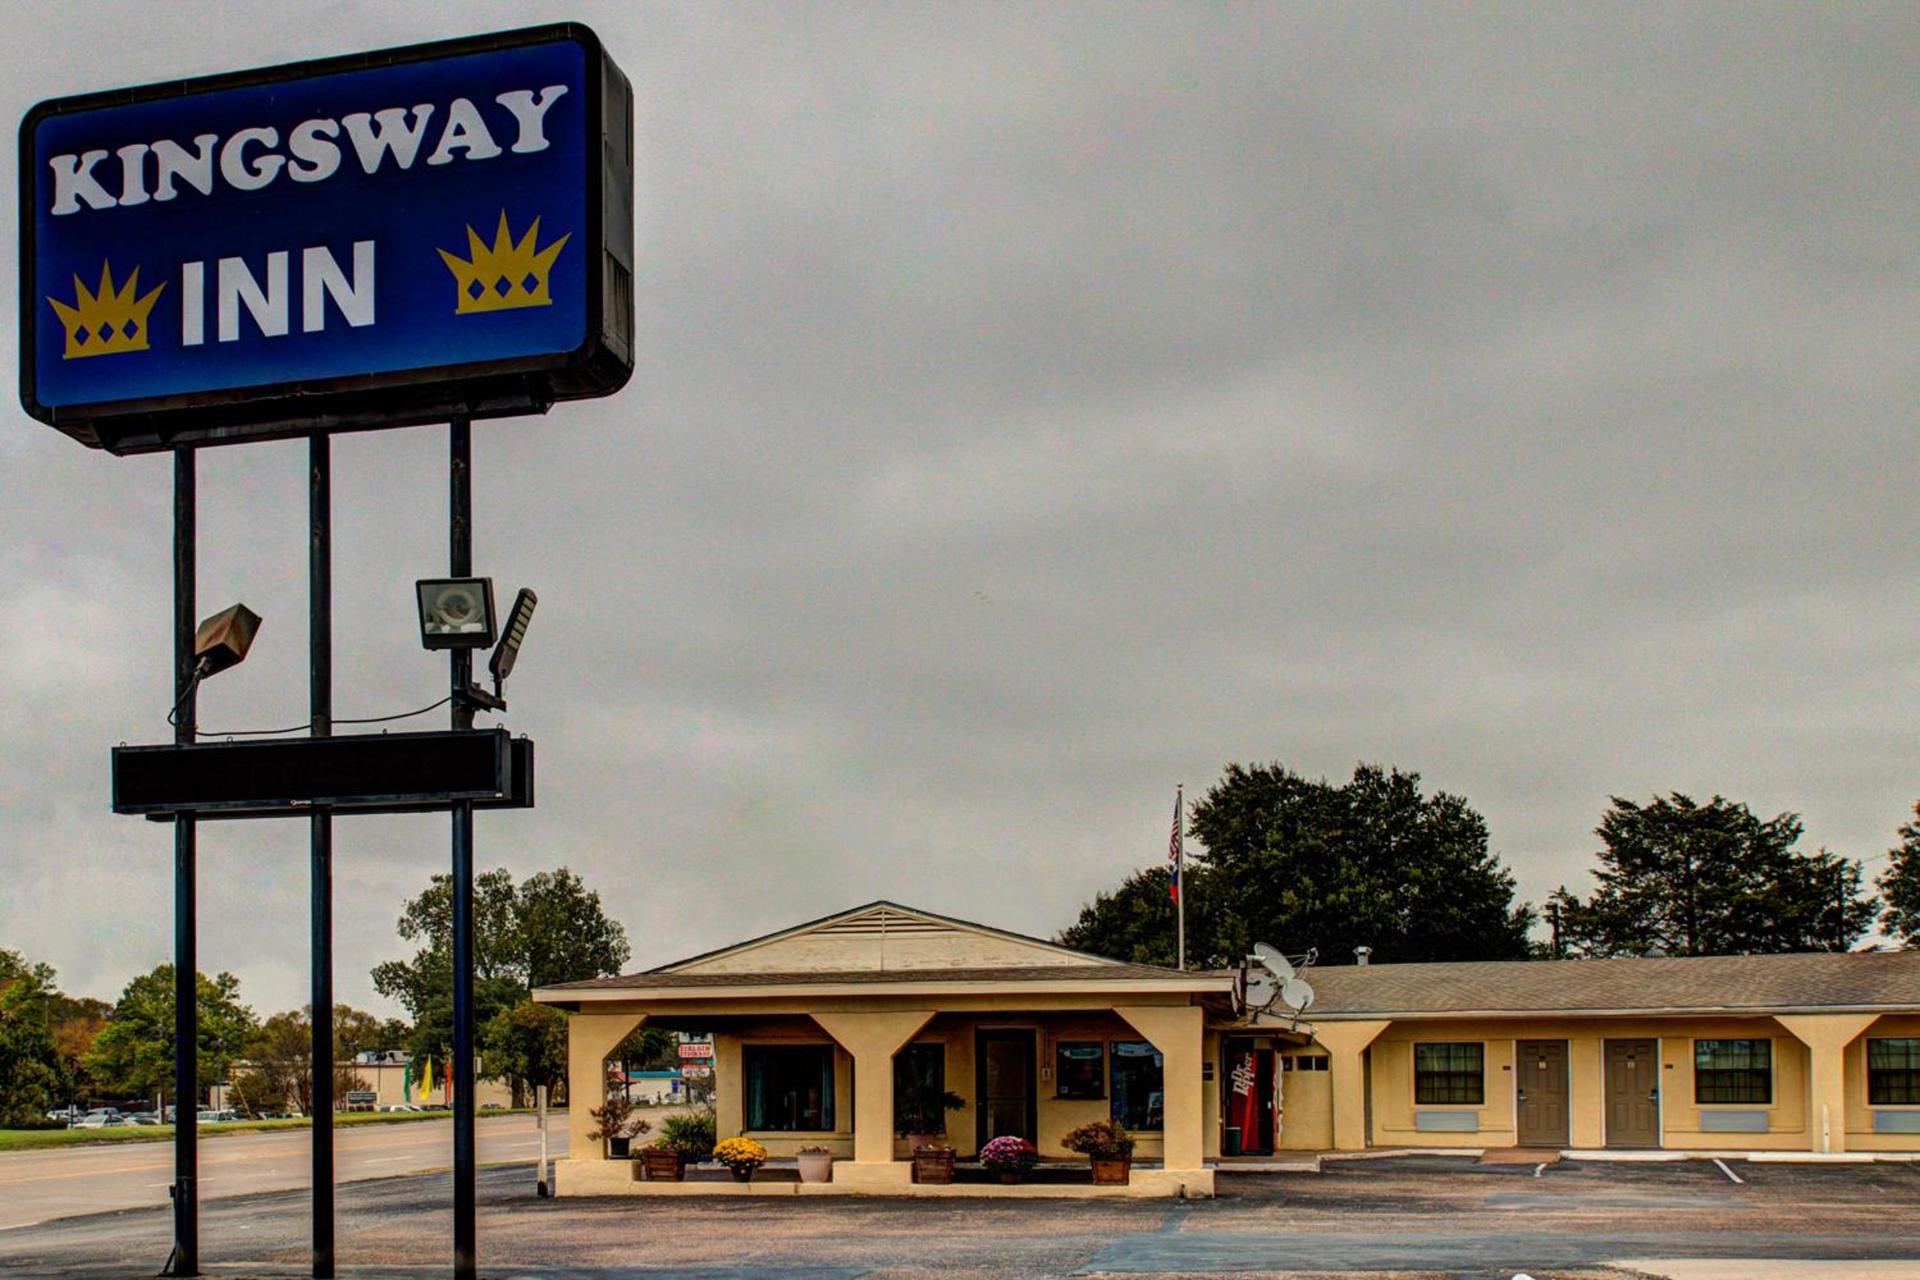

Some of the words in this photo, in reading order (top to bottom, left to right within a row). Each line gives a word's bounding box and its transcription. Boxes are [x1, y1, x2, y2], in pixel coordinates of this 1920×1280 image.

[50, 85, 568, 215] KINGSWAY
[182, 240, 375, 346] INN
[1231, 1063, 1244, 1081] Dr
[1233, 1052, 1255, 1096] Pepper
